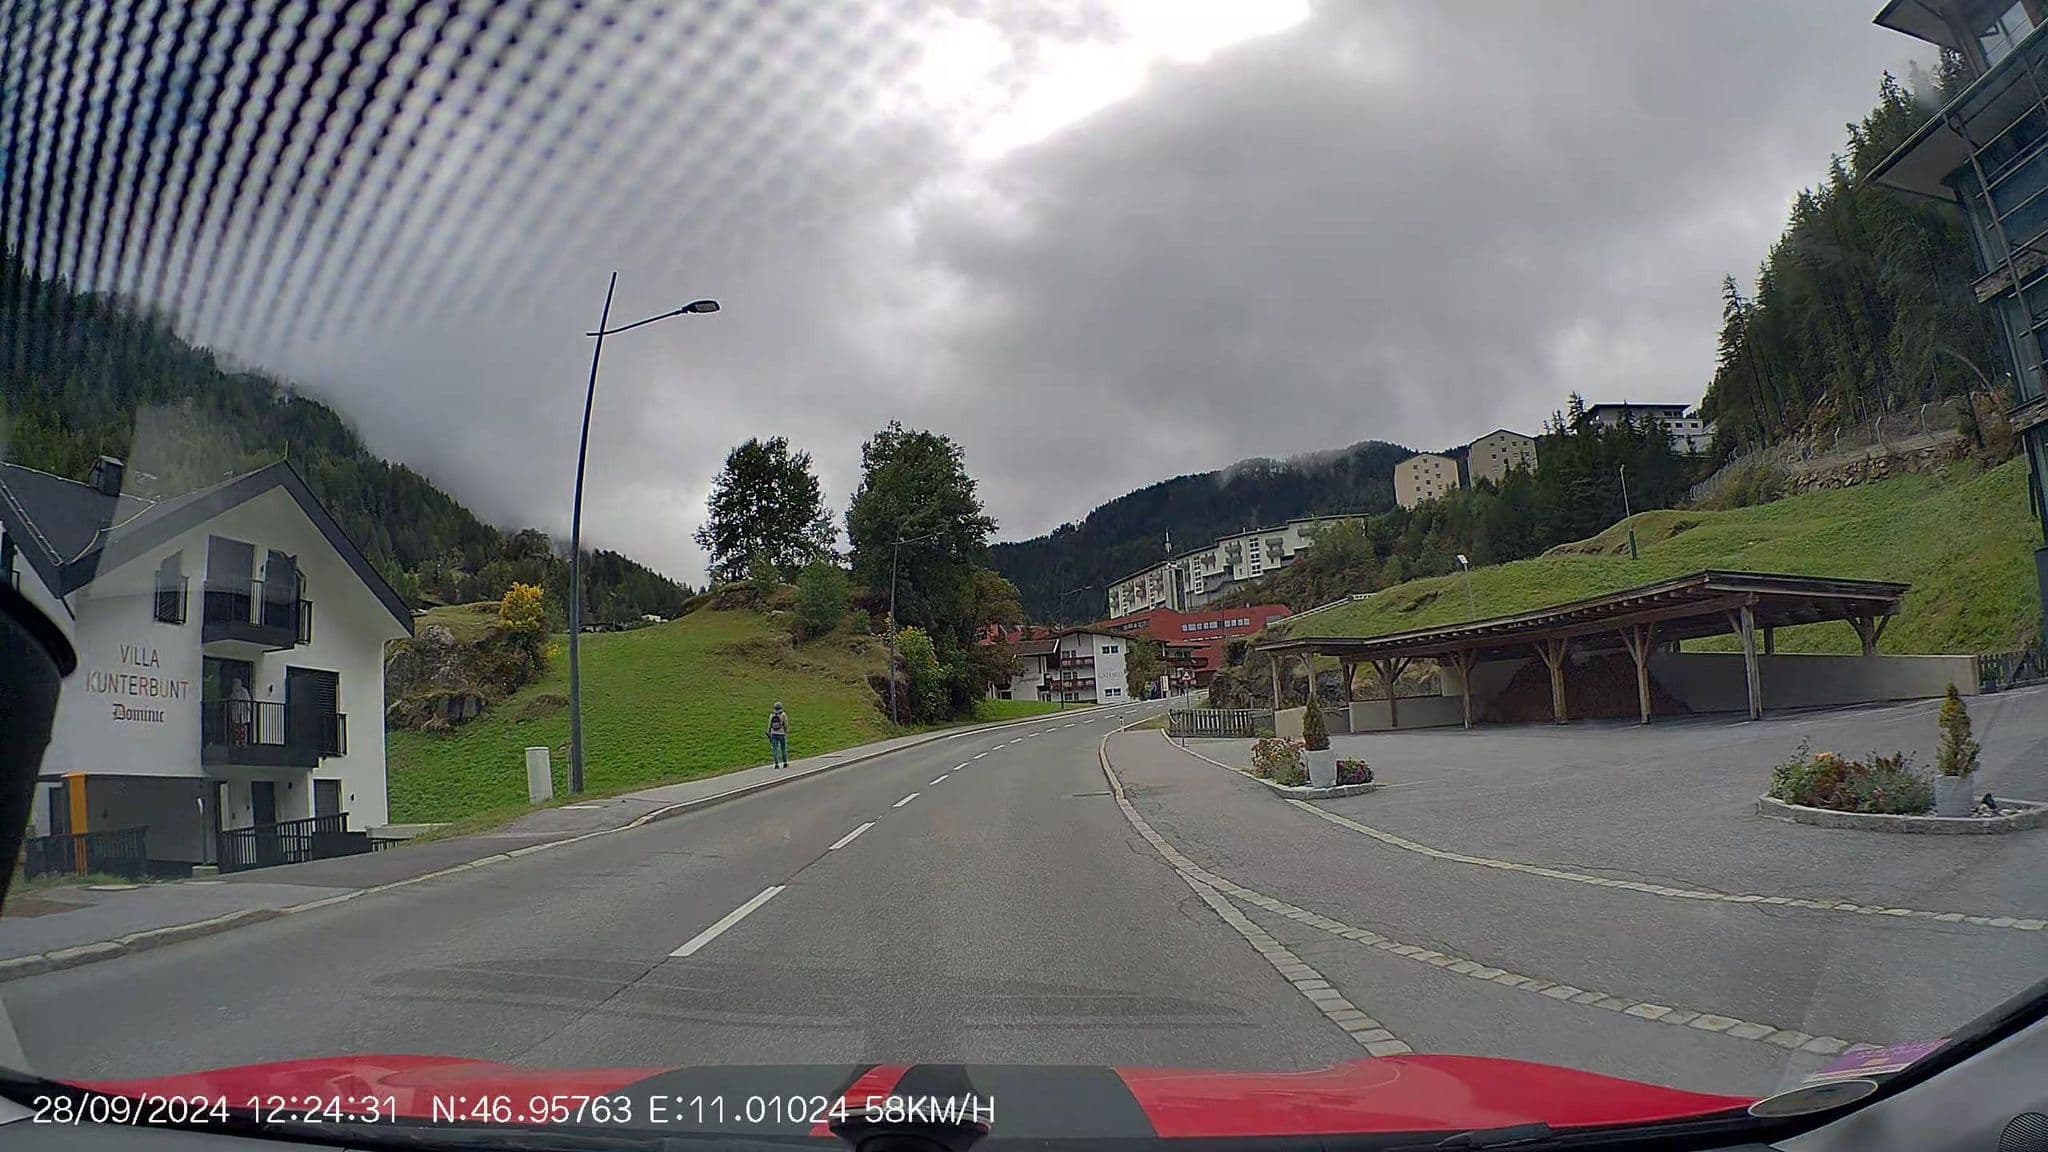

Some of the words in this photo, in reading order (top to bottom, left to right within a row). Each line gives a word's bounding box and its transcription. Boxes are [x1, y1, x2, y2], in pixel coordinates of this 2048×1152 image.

[119, 644, 160, 669] VILLA
[86, 671, 189, 700] KUNTERBUNT
[112, 703, 165, 723] Dominic
